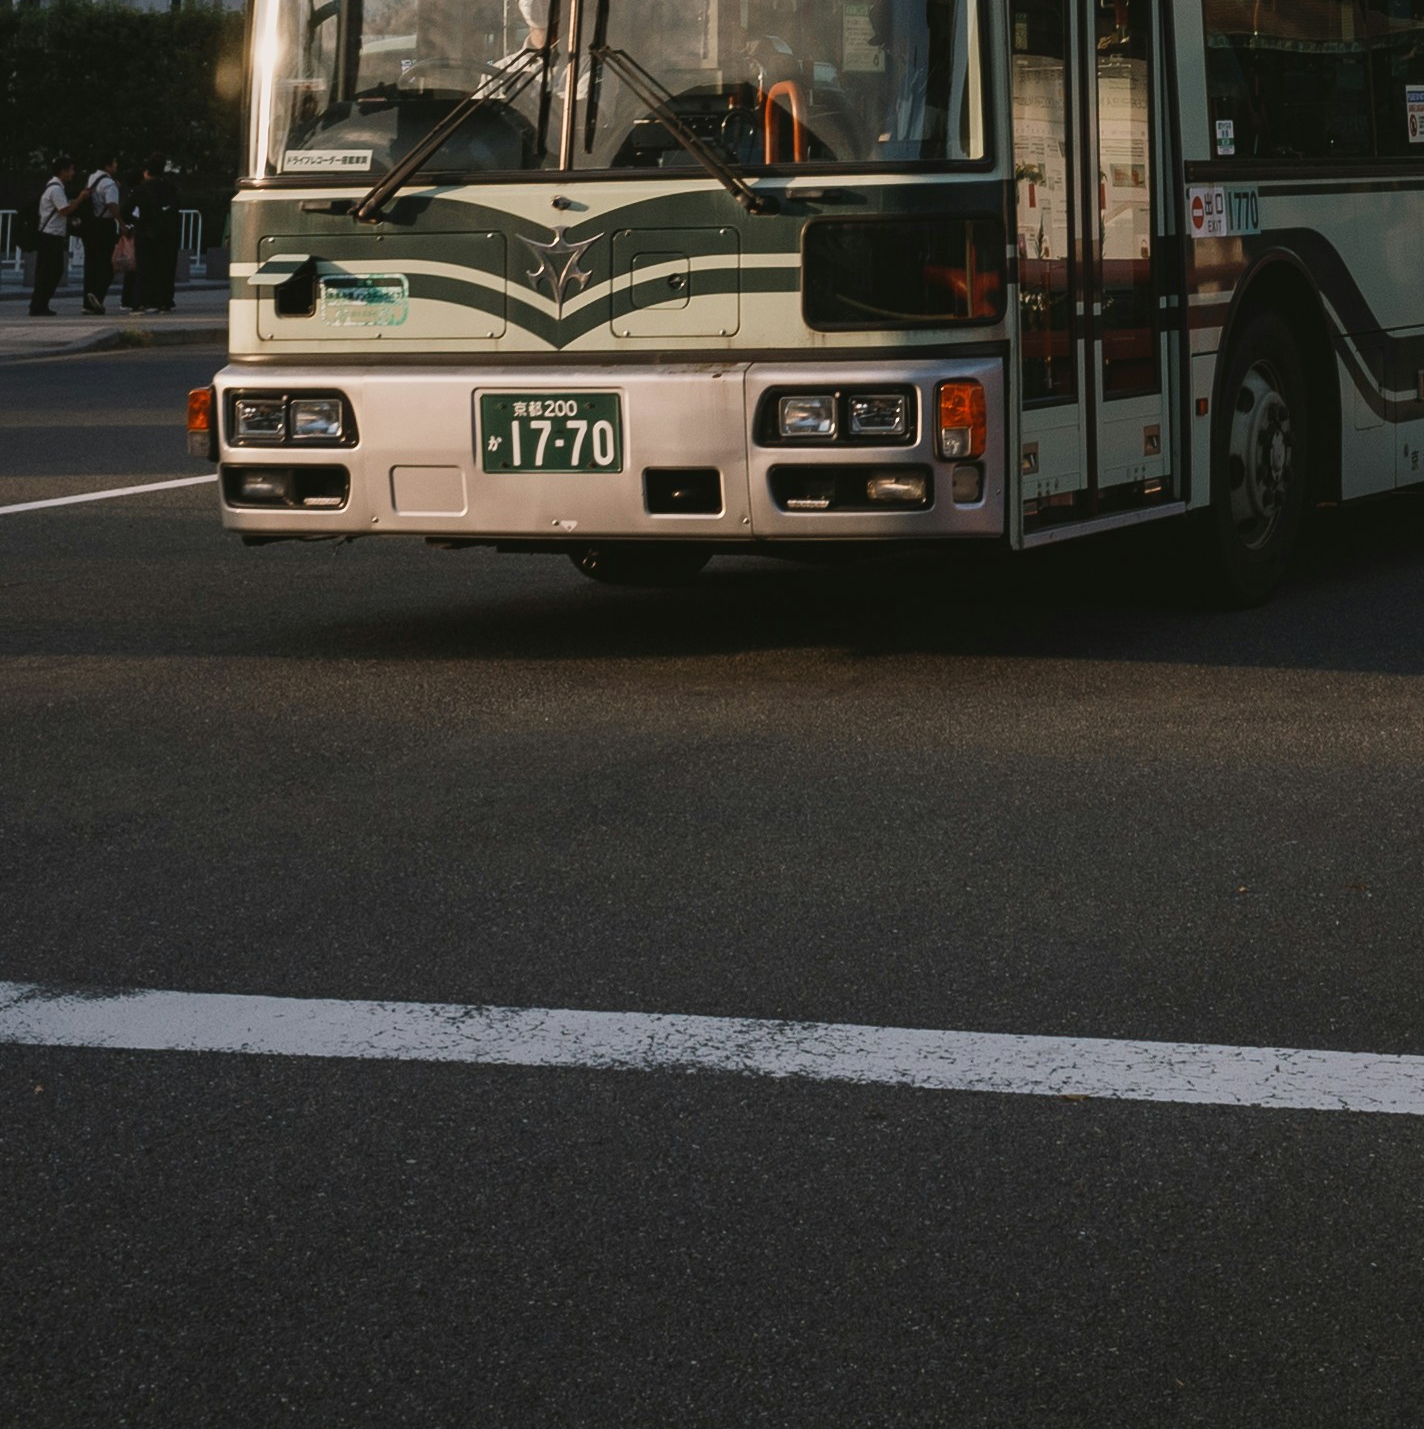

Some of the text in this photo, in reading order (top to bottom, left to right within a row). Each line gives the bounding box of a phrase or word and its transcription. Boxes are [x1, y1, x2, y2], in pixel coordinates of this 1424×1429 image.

[1204, 192, 1224, 216] 出口
[1228, 190, 1260, 231] 1770
[1207, 220, 1223, 233] EXIT
[487, 419, 615, 467] か 17-70
